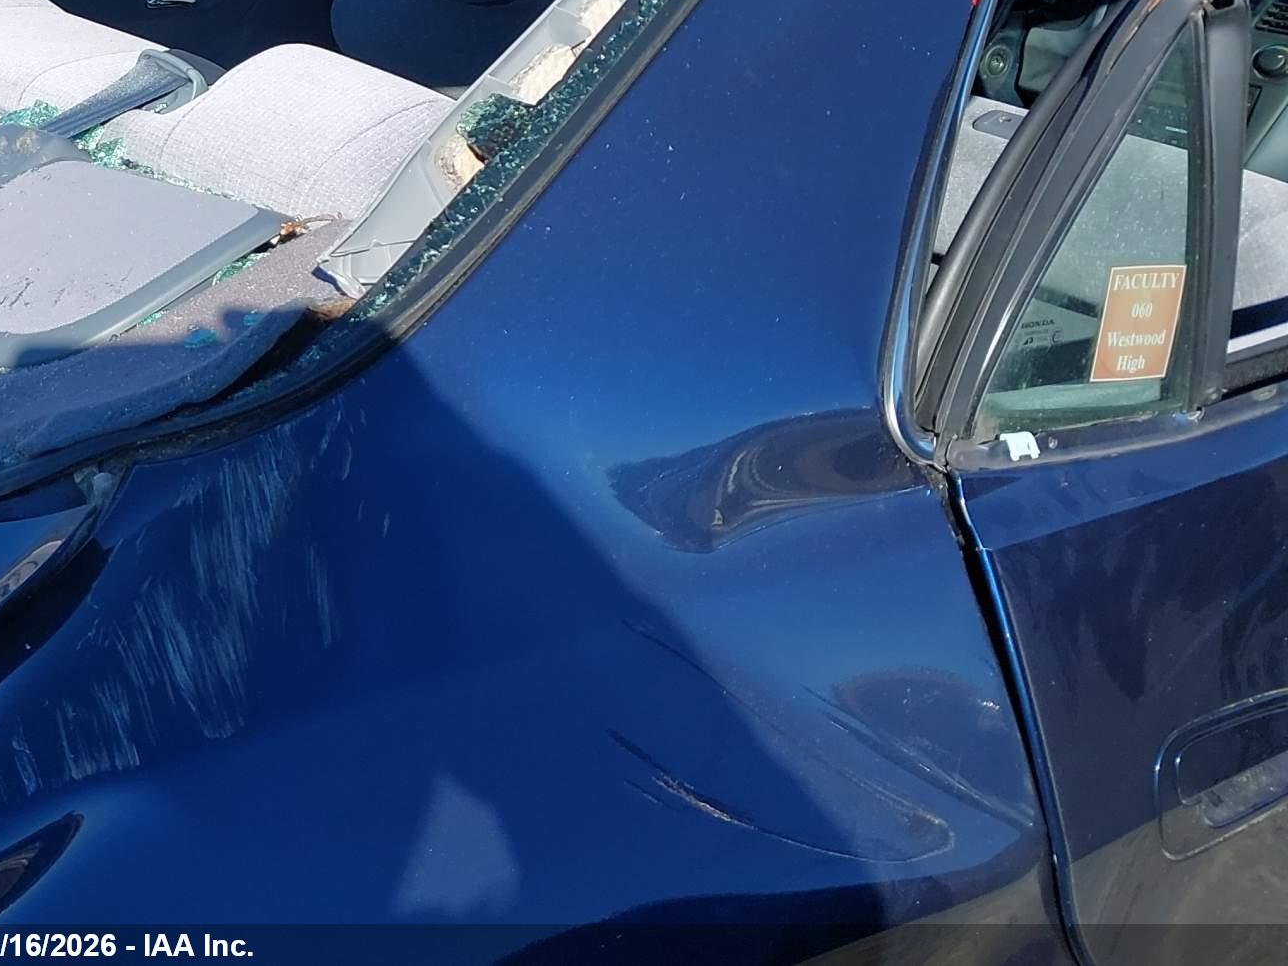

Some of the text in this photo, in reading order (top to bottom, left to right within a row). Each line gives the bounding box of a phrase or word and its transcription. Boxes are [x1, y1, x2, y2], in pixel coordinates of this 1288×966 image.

[1113, 272, 1180, 291] FACULTY
[1131, 302, 1153, 319] 060
[1107, 329, 1167, 347] Westwood
[1116, 354, 1146, 374] High
